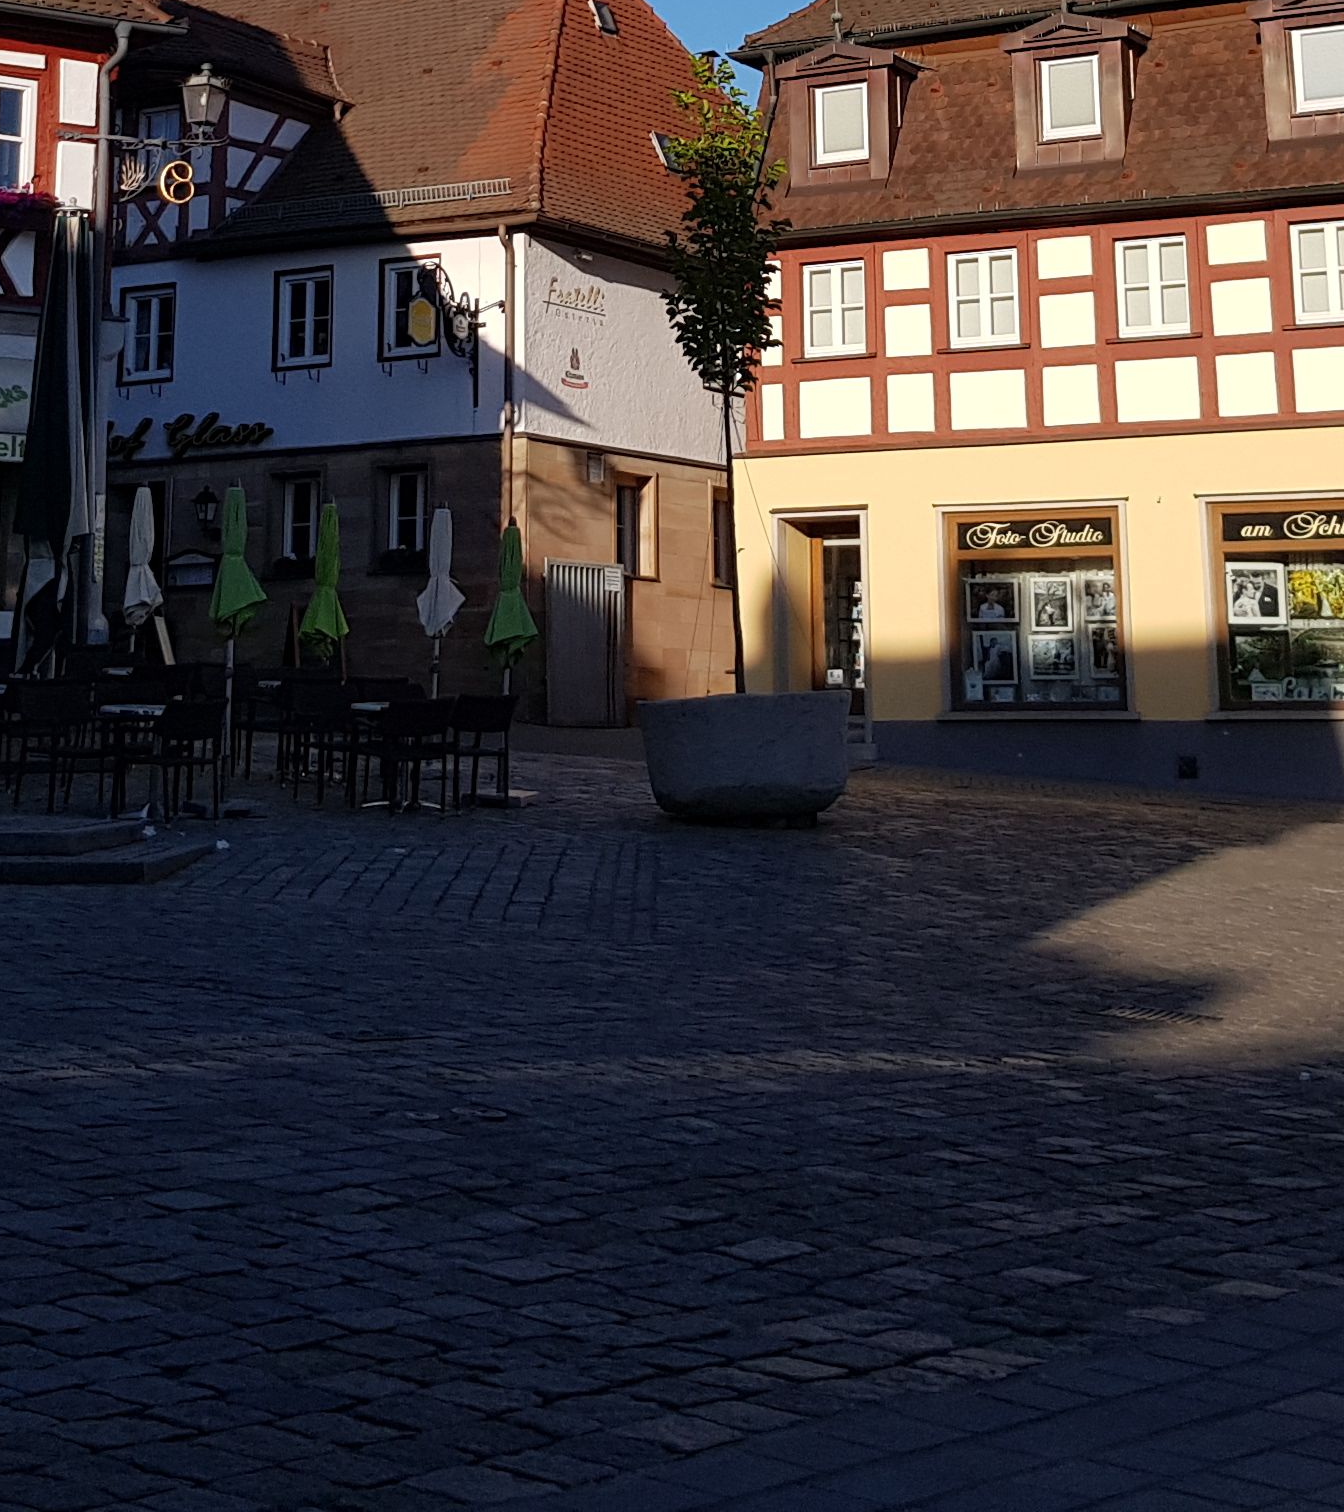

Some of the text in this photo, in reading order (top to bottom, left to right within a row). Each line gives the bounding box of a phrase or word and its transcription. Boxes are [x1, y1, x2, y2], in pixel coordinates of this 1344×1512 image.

[107, 417, 154, 461] of
[966, 520, 1104, 550] Foto-Studio
[1240, 524, 1274, 537] am
